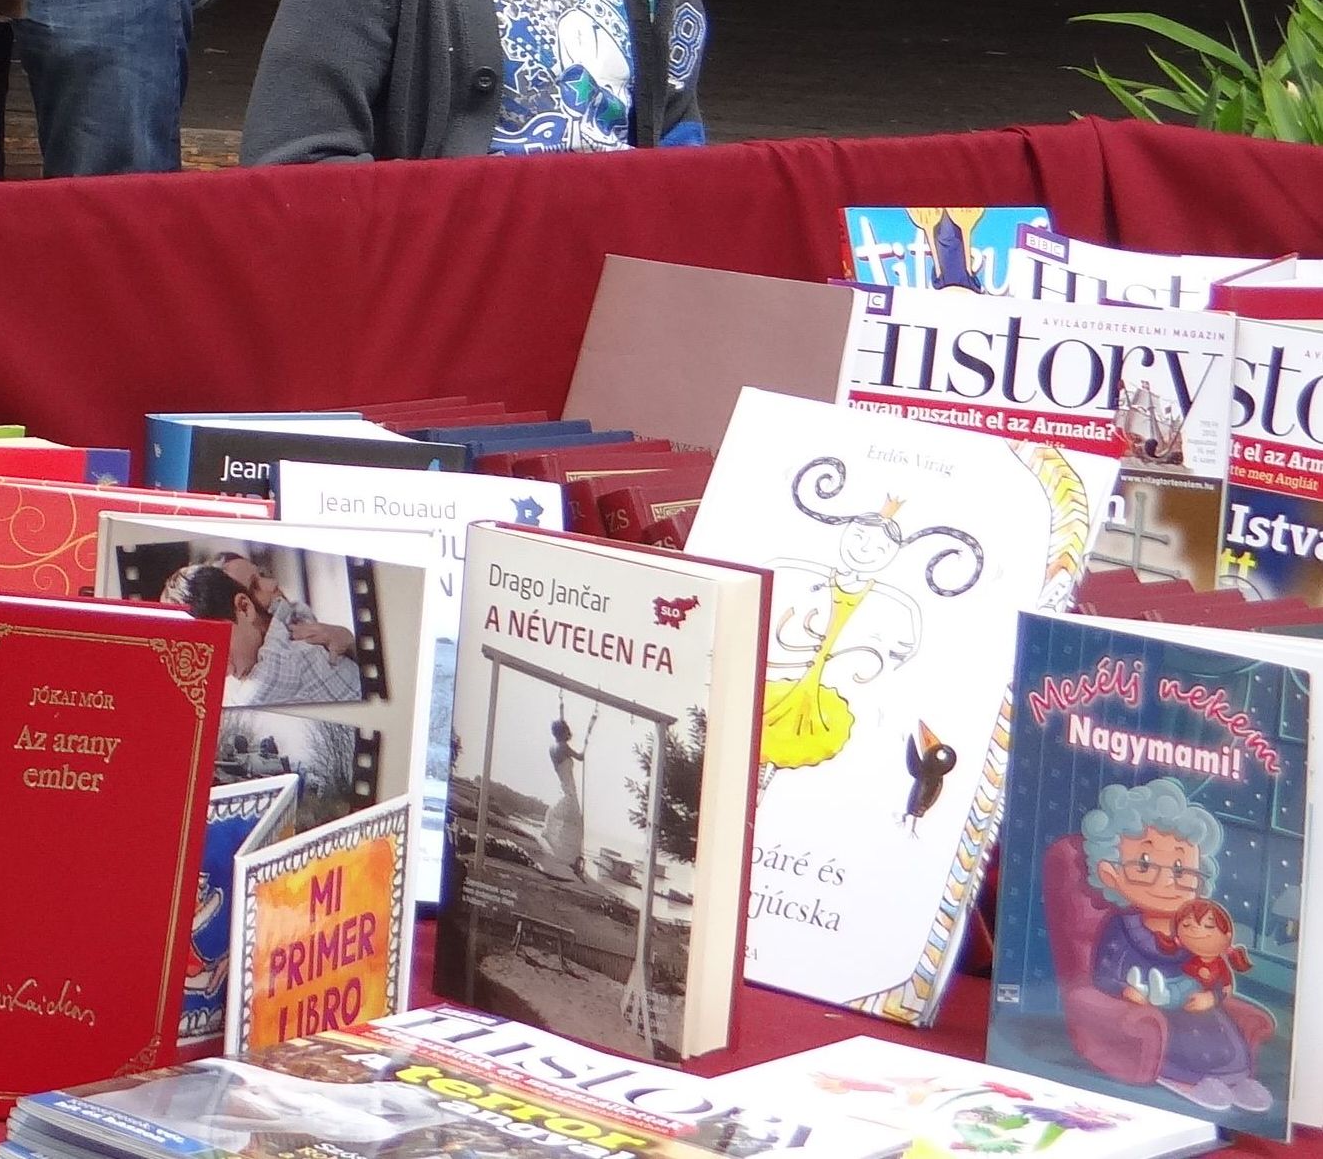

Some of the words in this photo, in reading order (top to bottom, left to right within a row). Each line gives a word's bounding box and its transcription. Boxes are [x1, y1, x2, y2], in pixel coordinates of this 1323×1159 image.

[1173, 329, 1226, 341] MAGAZIN
[907, 403, 983, 428] pusztult
[986, 412, 1004, 430] el
[1007, 417, 1030, 433] az
[1033, 418, 1116, 442] Armada?
[220, 456, 271, 481] Jean
[1244, 443, 1262, 462] el
[1264, 449, 1286, 467] az
[1247, 468, 1274, 484] meg
[318, 491, 366, 516] Jean
[374, 495, 457, 520] Rouaud
[489, 563, 544, 600] Drago
[548, 578, 610, 613] Jančar
[660, 605, 680, 618] SLO
[484, 605, 500, 632] A
[508, 608, 634, 665] NÉVTELEN
[642, 643, 674, 675] FA
[29, 685, 77, 706] JÓKAI
[78, 690, 115, 710] MÓR
[1029, 656, 1145, 724] Mesélj
[1159, 678, 1281, 776] nekem
[13, 725, 47, 751] Az
[52, 733, 121, 763] arany
[1069, 713, 1241, 780] Nagymami!
[23, 764, 104, 793] ember
[817, 858, 846, 886] és
[309, 865, 343, 923] MI
[268, 911, 377, 999] PRIMER
[279, 976, 362, 1042] LIBRO
[342, 1052, 392, 1072] A
[395, 1064, 648, 1150] terror
